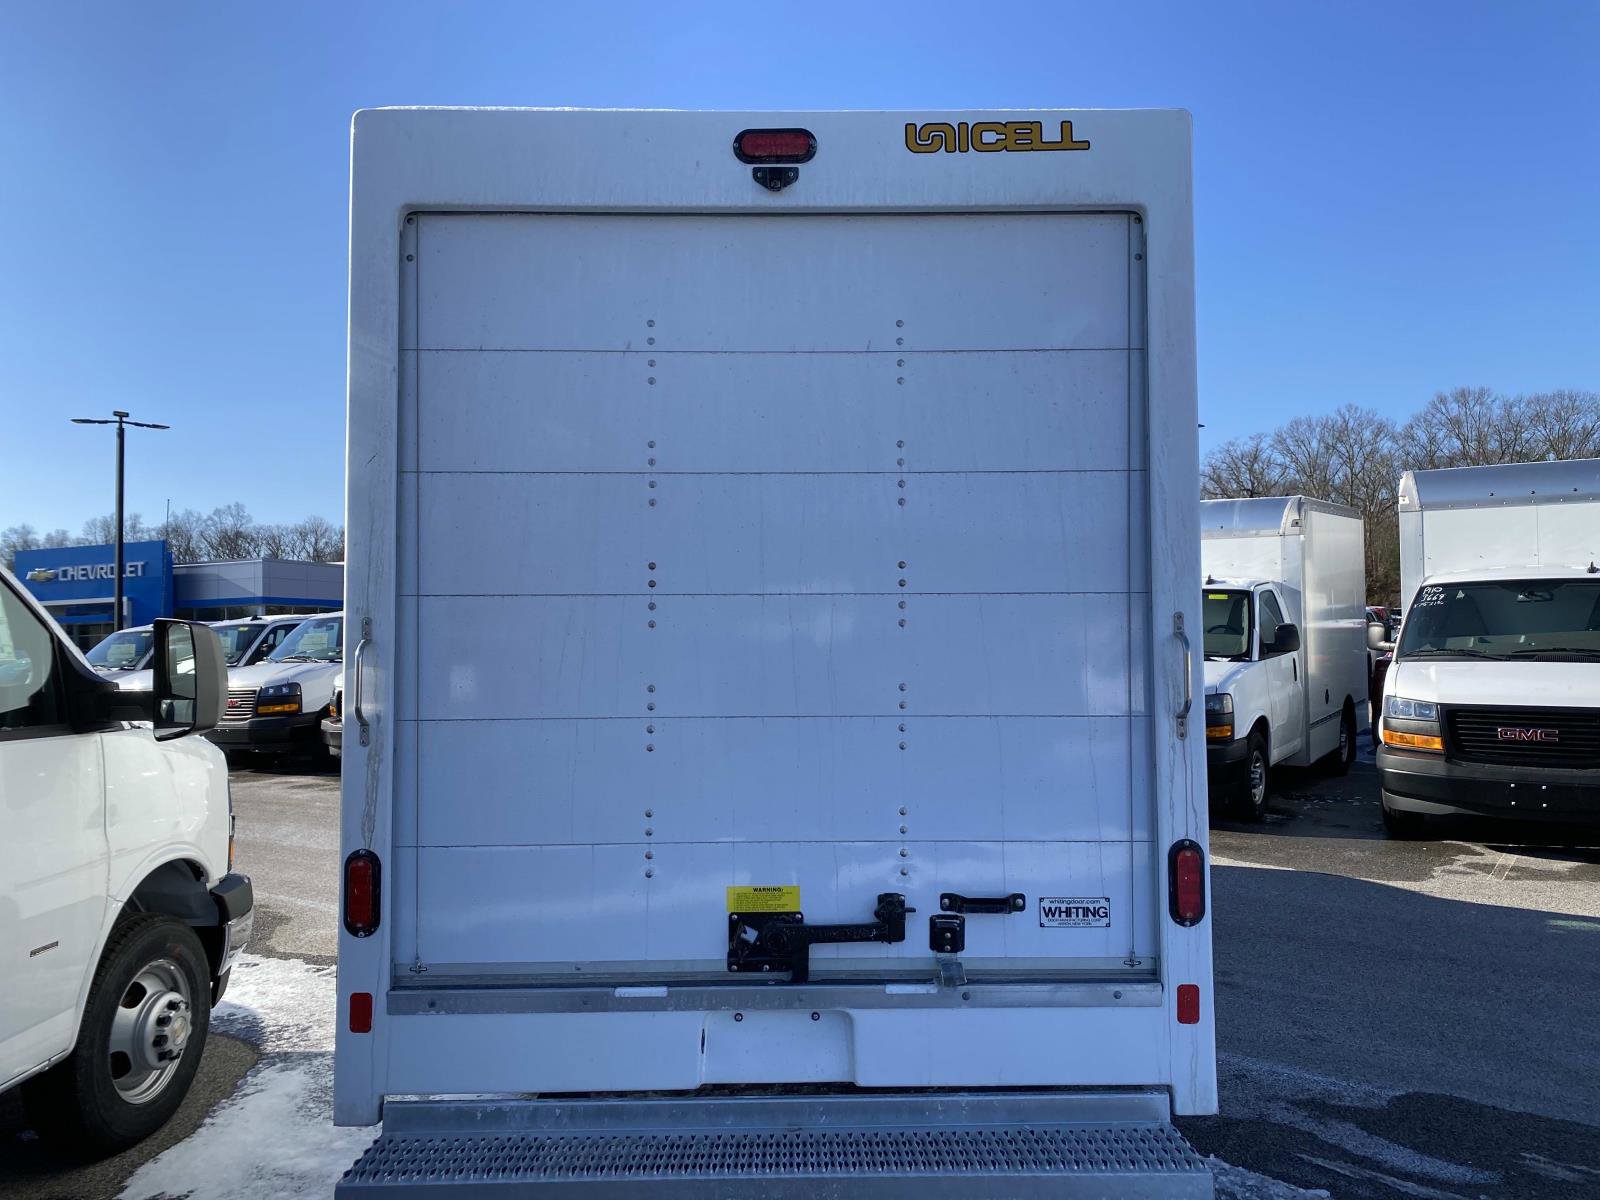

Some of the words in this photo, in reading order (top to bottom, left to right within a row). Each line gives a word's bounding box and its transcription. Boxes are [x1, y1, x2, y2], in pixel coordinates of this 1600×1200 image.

[905, 120, 1091, 153] UNICELL
[58, 561, 145, 581] CHEVROET
[1497, 727, 1559, 743] GMC
[1042, 906, 1109, 918] WHITING
